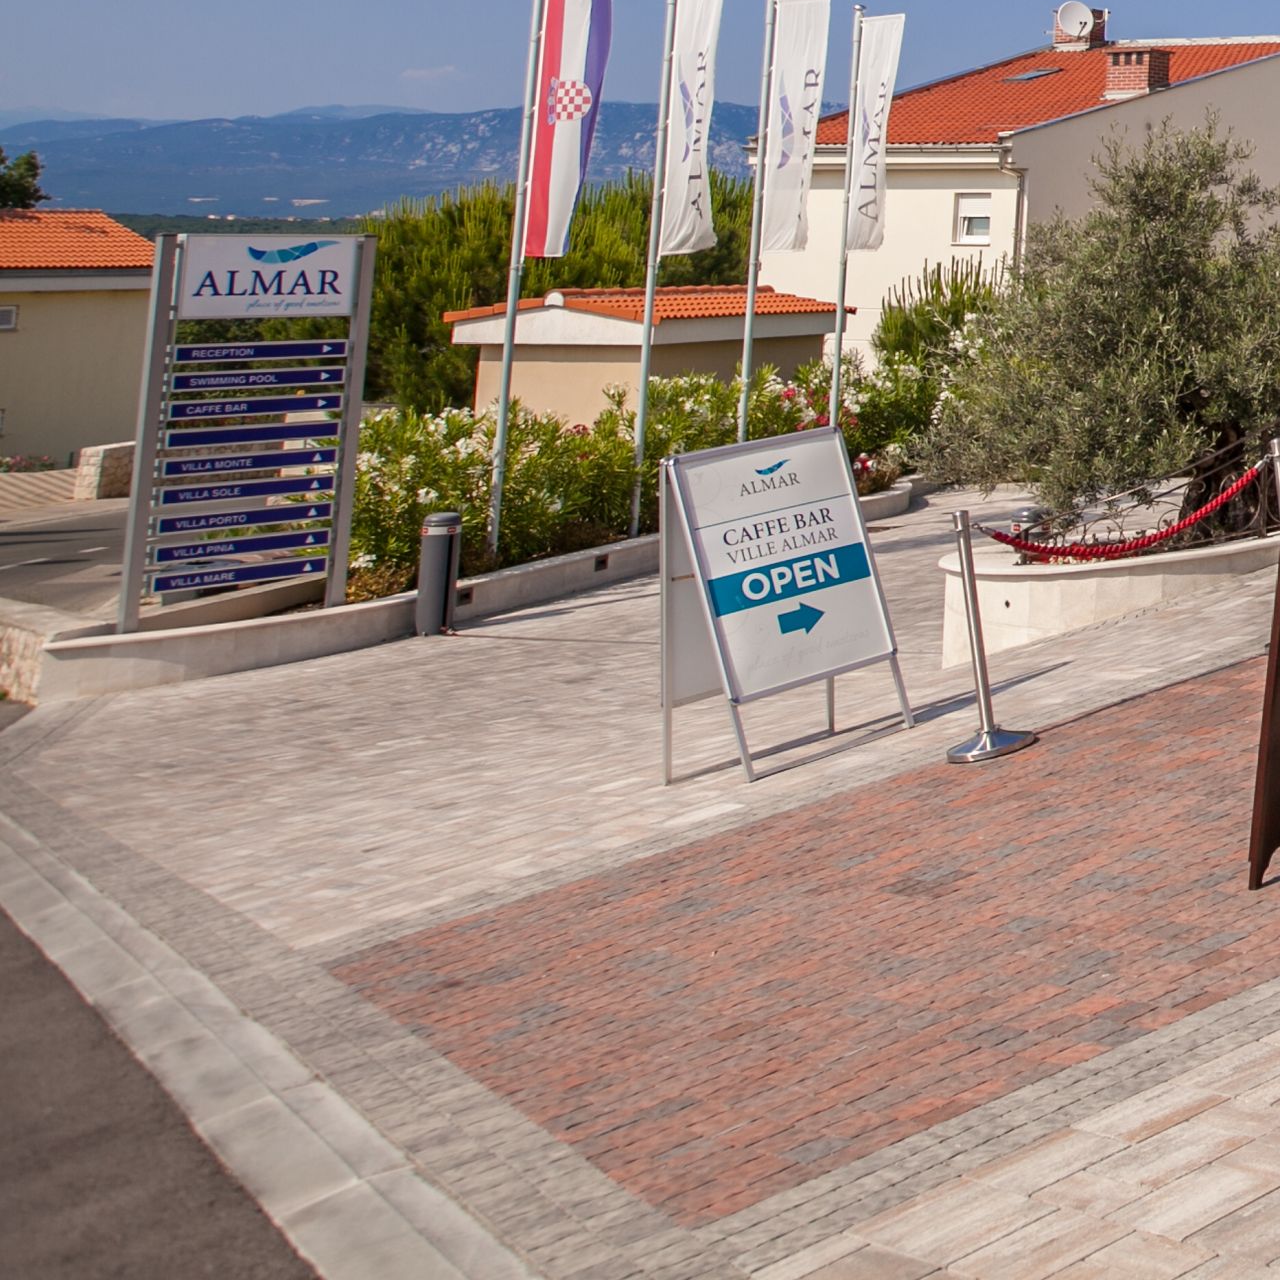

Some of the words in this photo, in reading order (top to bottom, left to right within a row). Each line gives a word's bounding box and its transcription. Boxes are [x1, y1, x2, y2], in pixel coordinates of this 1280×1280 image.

[192, 269, 342, 297] ALMAR
[191, 348, 255, 358] RECEPTION
[189, 375, 247, 387] SWIMMING
[248, 374, 278, 384] POOL
[186, 405, 222, 415] CAFFE
[225, 403, 248, 413] BAR
[181, 462, 212, 472] VILLA
[214, 458, 254, 469] MONTE
[739, 472, 801, 497] ALMAR
[178, 490, 209, 500] VILLA
[211, 487, 241, 498] SOLE
[175, 518, 207, 529] VILLA
[208, 514, 248, 526] PORTO
[723, 516, 790, 547] CAFFE
[792, 507, 834, 531] BAR
[172, 547, 204, 557] VILLA
[206, 543, 235, 554] PINIA
[726, 542, 778, 565] VILLE
[781, 527, 839, 552] ALMAR
[170, 576, 202, 587] VILLA
[203, 572, 236, 582] MARE
[741, 553, 841, 601] OPEN
